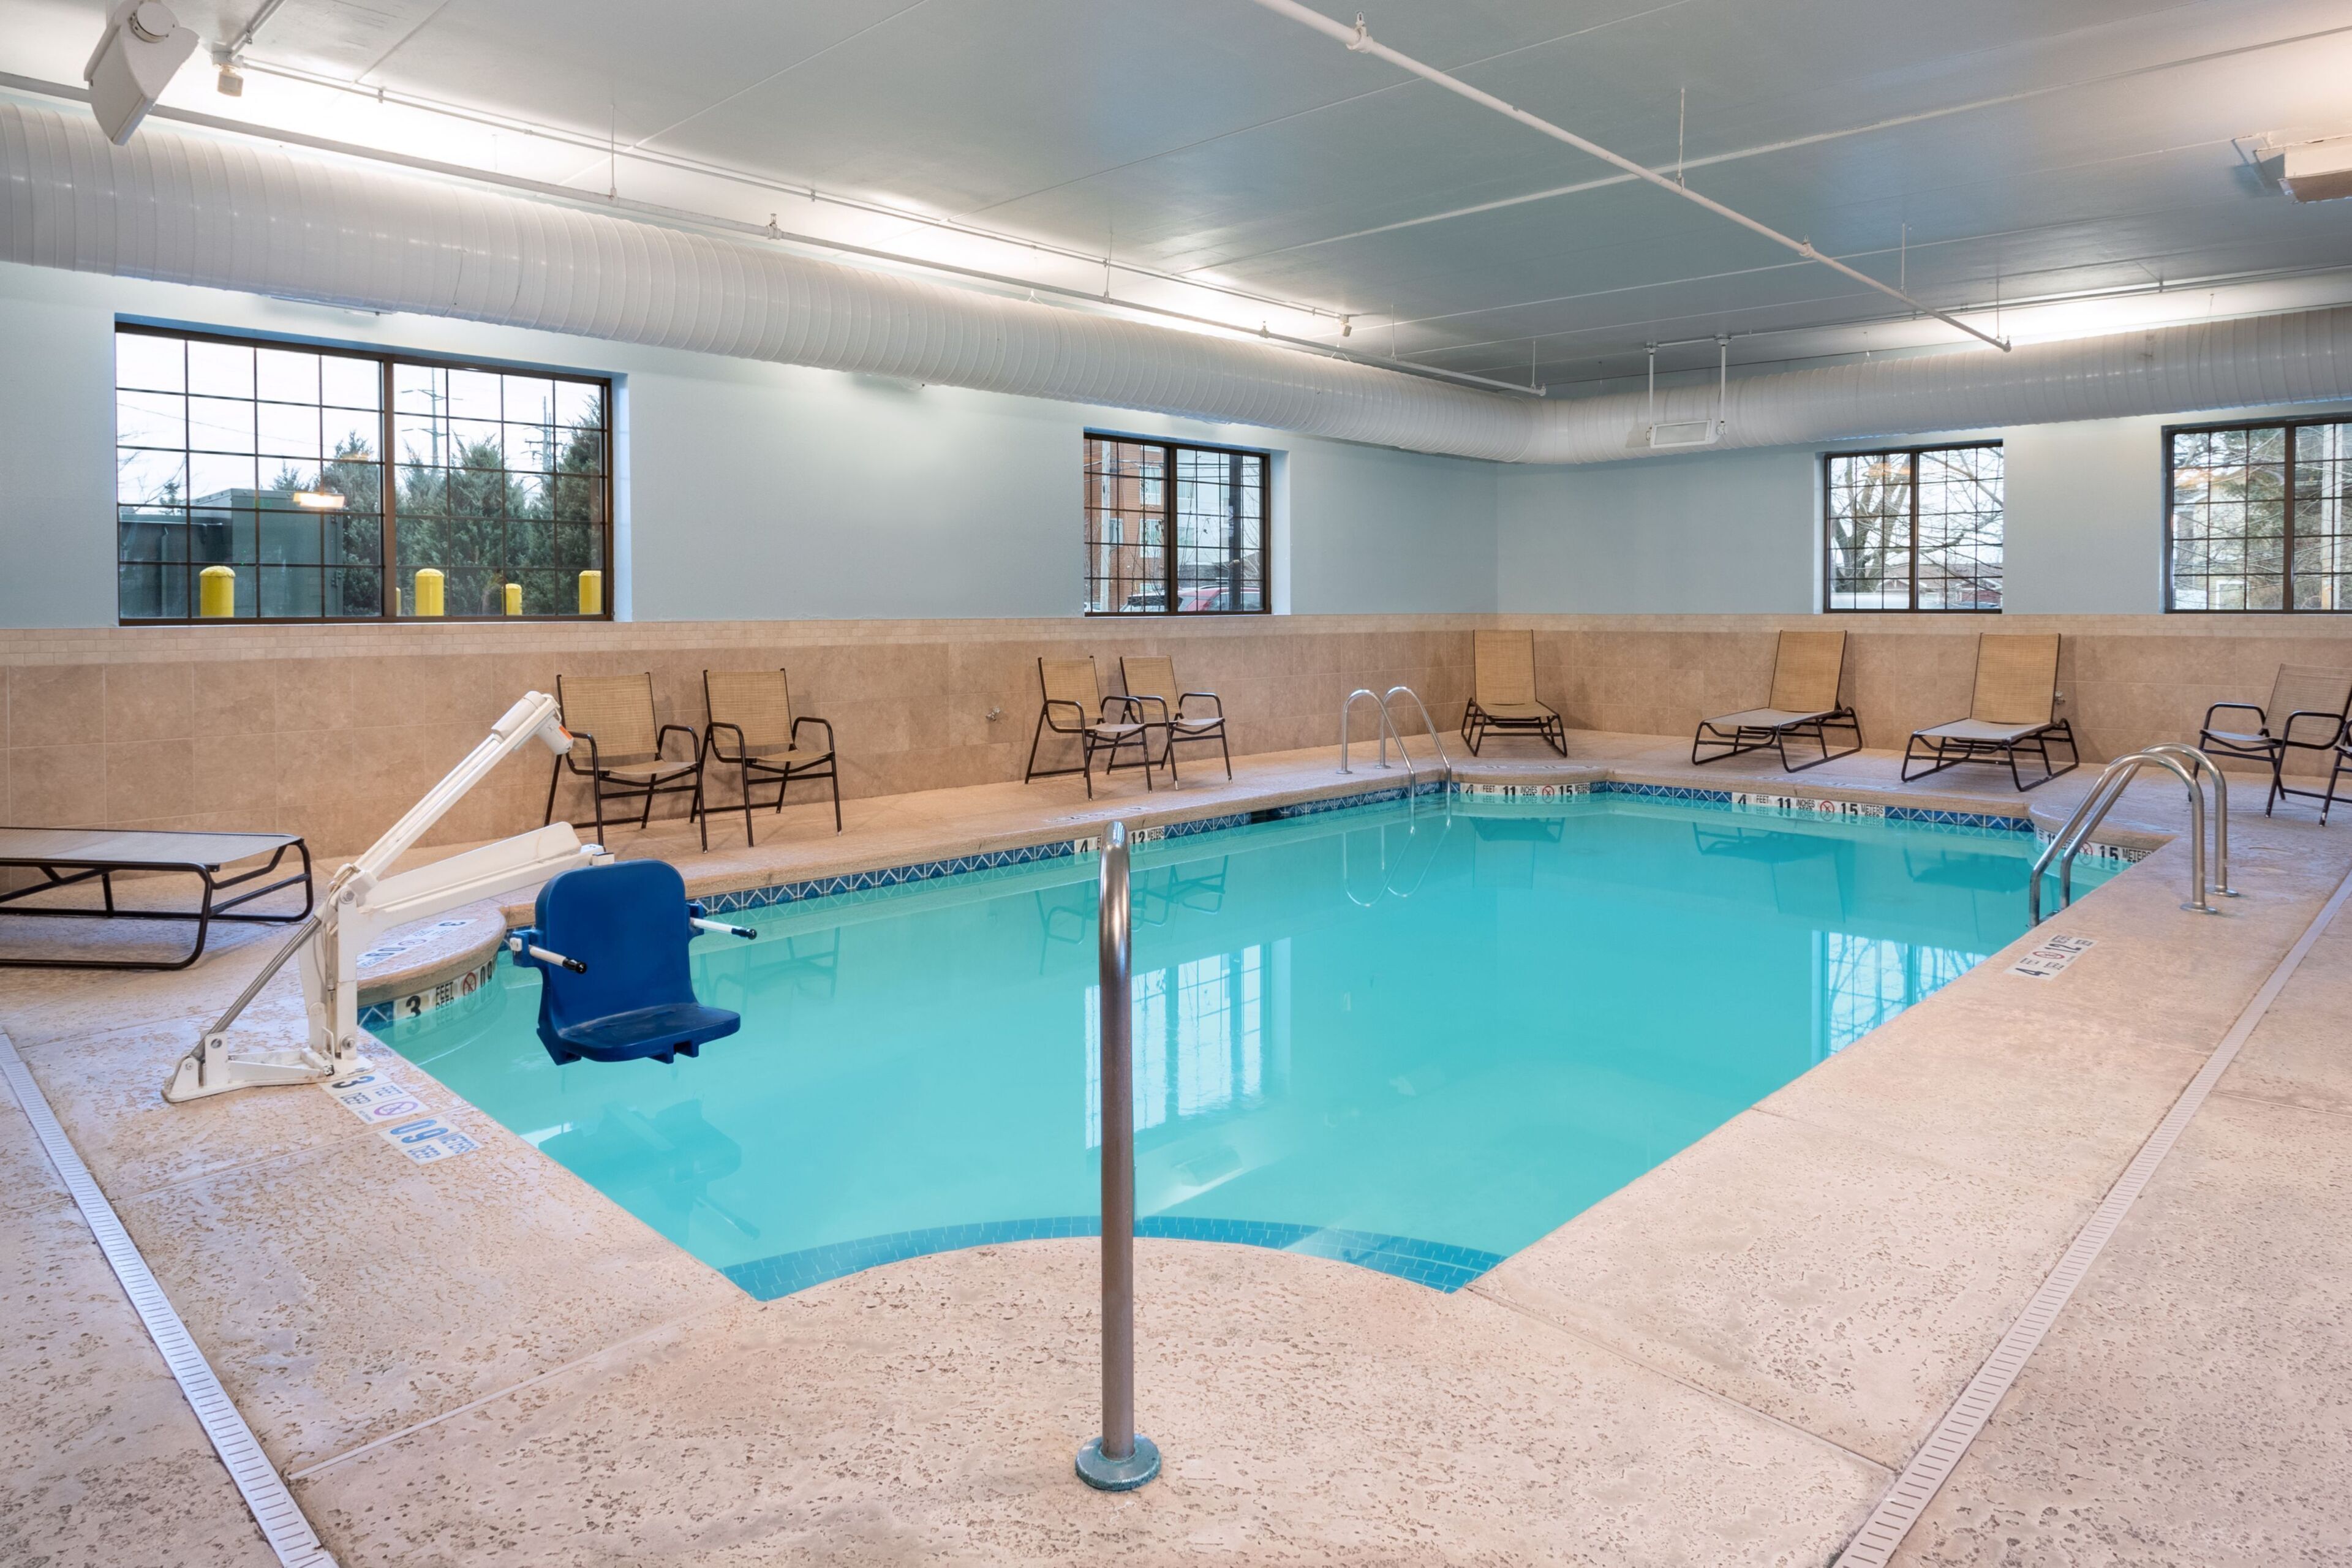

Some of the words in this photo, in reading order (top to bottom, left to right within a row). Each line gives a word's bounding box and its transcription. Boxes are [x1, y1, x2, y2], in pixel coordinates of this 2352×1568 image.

[1503, 786, 1516, 796] 11
[1520, 786, 1538, 794] INCHES
[1738, 794, 1747, 804] 4
[1756, 795, 1770, 804] FEET
[1777, 797, 1791, 809] 11
[1796, 799, 1815, 809] INCHES
[1861, 804, 1884, 815] METERS
[1080, 839, 1088, 853] 4
[1147, 827, 1164, 839] METERS
[2015, 967, 2050, 976] 4
[405, 995, 421, 1019] 3
[435, 981, 454, 1003] FEET
[331, 1076, 375, 1089] 3
[375, 1085, 404, 1096] FEET
[340, 1092, 372, 1105] DEEP
[407, 1144, 442, 1160] DEEP
